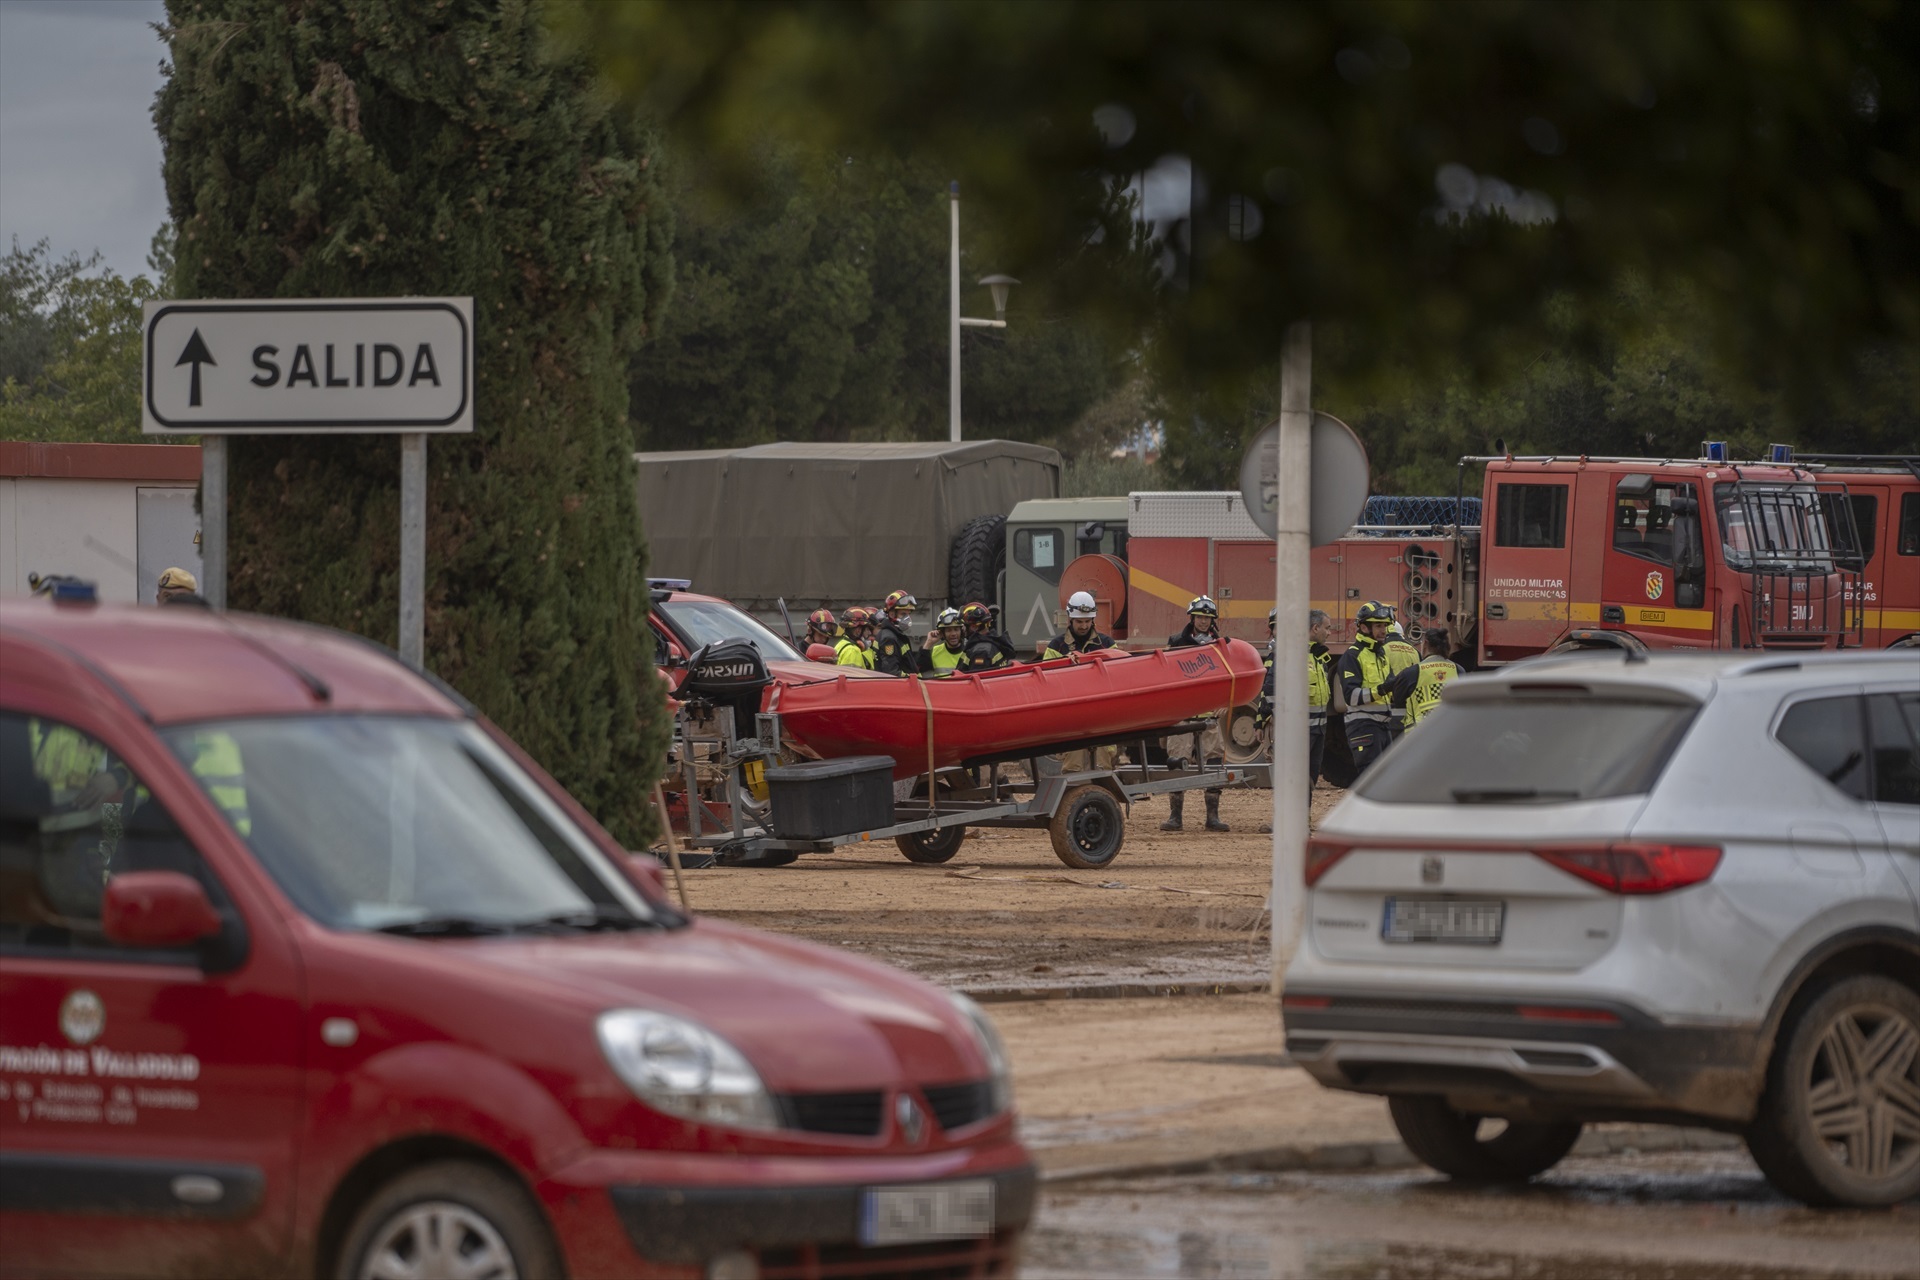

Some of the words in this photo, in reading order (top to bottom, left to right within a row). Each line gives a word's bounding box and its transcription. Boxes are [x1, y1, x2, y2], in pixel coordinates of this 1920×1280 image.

[250, 343, 442, 389] SALIDA
[1493, 578, 1527, 587] UNIDAD
[1528, 579, 1563, 588] MILITAR
[1489, 588, 1501, 597] DE
[1642, 612, 1660, 620] BIEM
[697, 663, 754, 678] PARSUN
